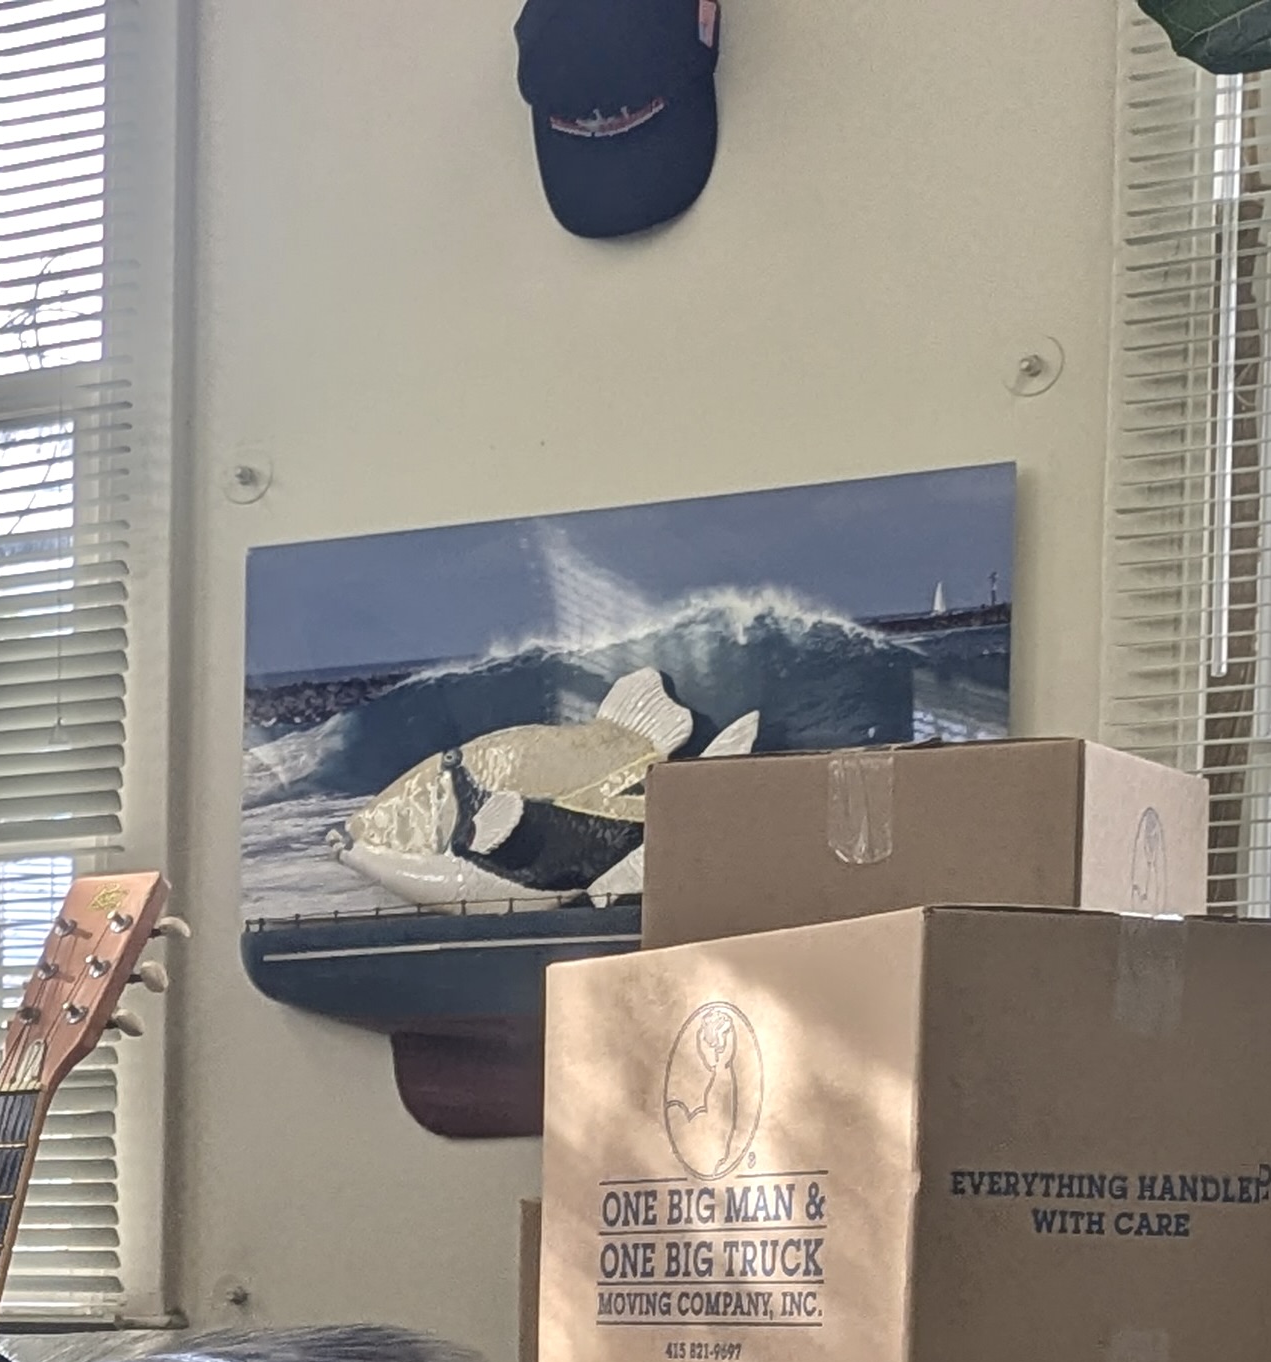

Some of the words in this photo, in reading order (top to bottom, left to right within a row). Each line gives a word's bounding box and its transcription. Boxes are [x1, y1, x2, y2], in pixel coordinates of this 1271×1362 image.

[950, 1171, 1128, 1200] EVERYTHING
[602, 1189, 658, 1227] ONE
[667, 1187, 715, 1225] BIG
[724, 1183, 795, 1224] MAN
[805, 1181, 826, 1221] &
[1031, 1208, 1105, 1235] WITH
[1114, 1212, 1191, 1237] CARE
[600, 1242, 656, 1279] ONE
[665, 1241, 714, 1278] BIG
[723, 1238, 824, 1277] TRUCK
[597, 1292, 671, 1316] MOVING
[677, 1291, 774, 1320] COMPANY,
[780, 1291, 823, 1317] INC.
[665, 1343, 685, 1359] 415
[689, 1343, 742, 1360] 821-9697
